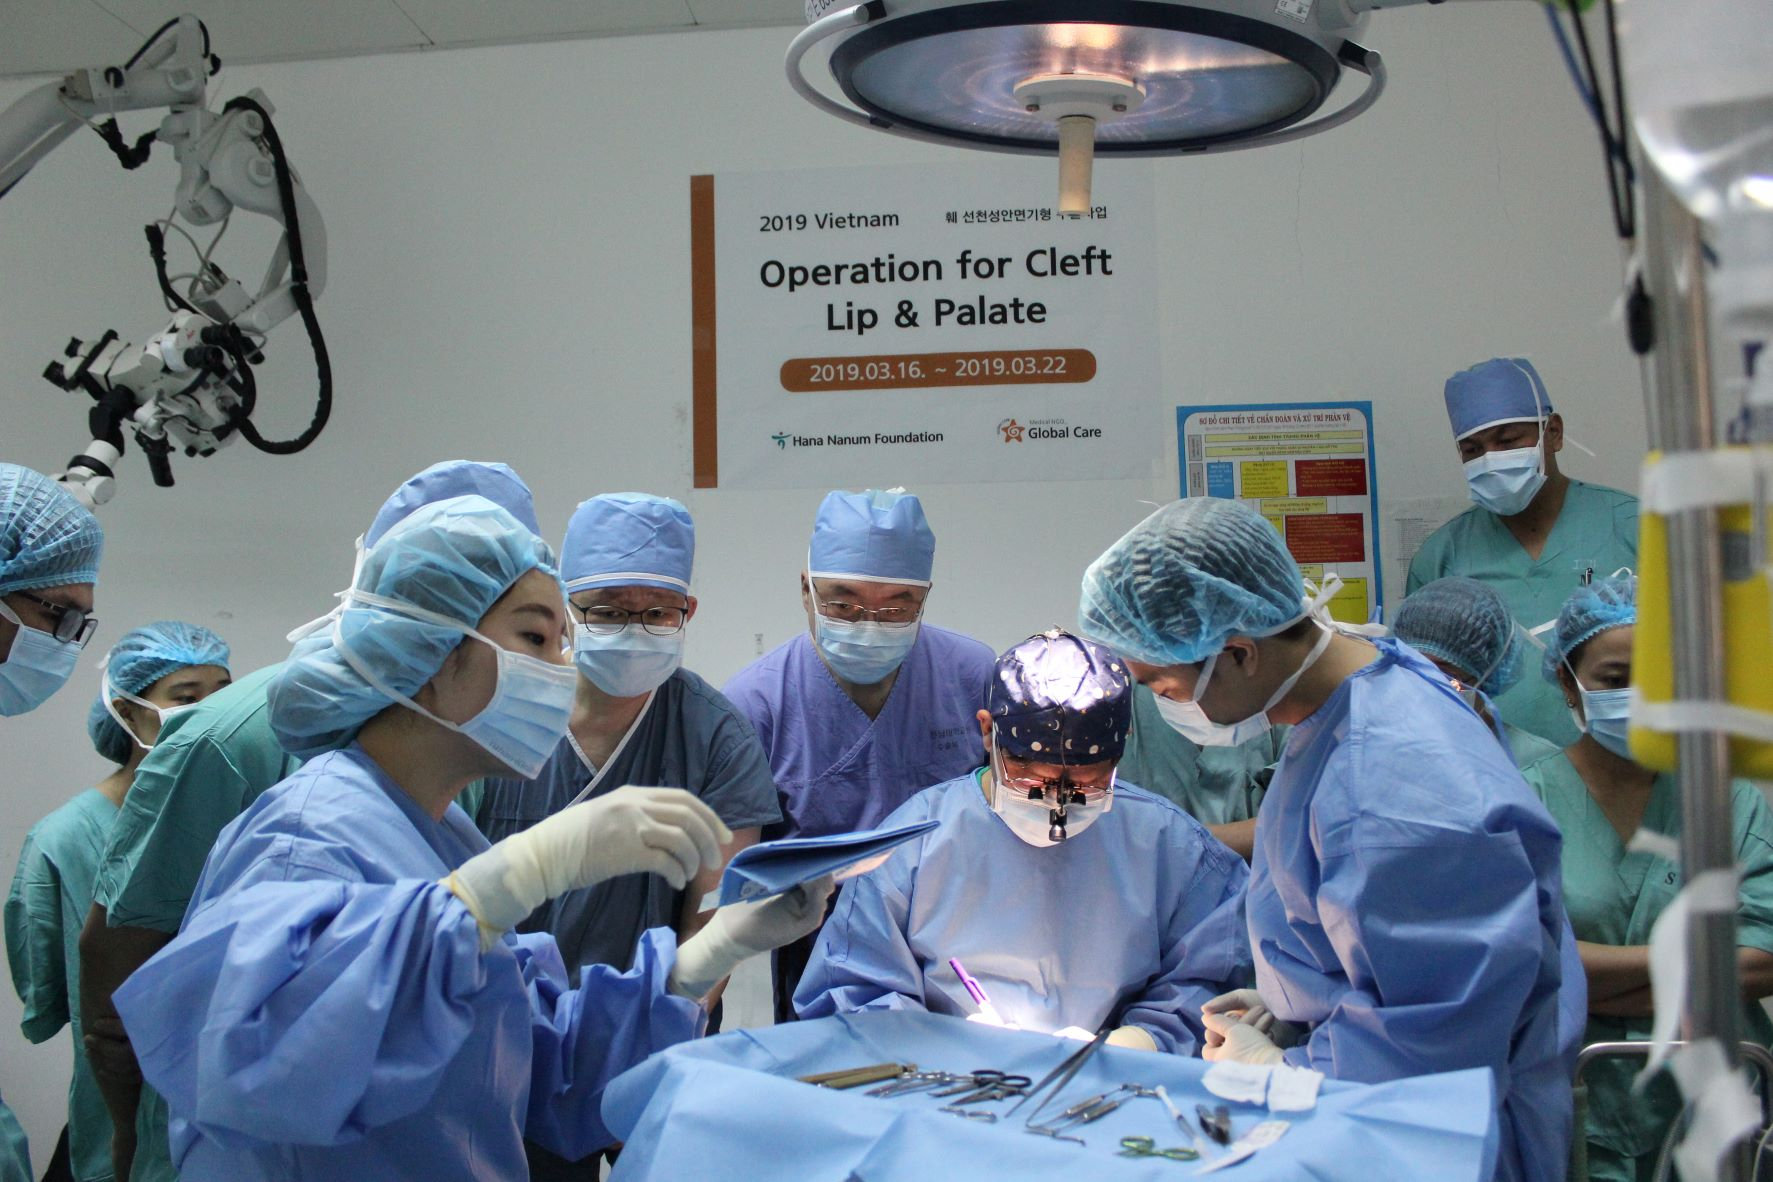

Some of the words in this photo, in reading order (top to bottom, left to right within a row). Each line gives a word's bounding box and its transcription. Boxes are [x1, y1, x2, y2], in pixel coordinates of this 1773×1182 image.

[760, 214, 807, 232] 2019
[814, 212, 900, 230] Vietnam
[962, 208, 1052, 223] 선천성안면기형
[760, 253, 943, 293] Operation
[955, 250, 1013, 280] for
[1025, 245, 1113, 278] Cleft
[827, 301, 879, 335] Lip
[894, 299, 920, 329] &
[934, 294, 1047, 327] Palate
[809, 360, 926, 383] 2019.03.16.
[955, 356, 1067, 377] 2019.03.22
[793, 435, 824, 447] Hana
[827, 434, 871, 446] Nanum
[874, 431, 944, 445] Foundation
[1028, 426, 1069, 439] Global
[1073, 426, 1102, 438] Care
